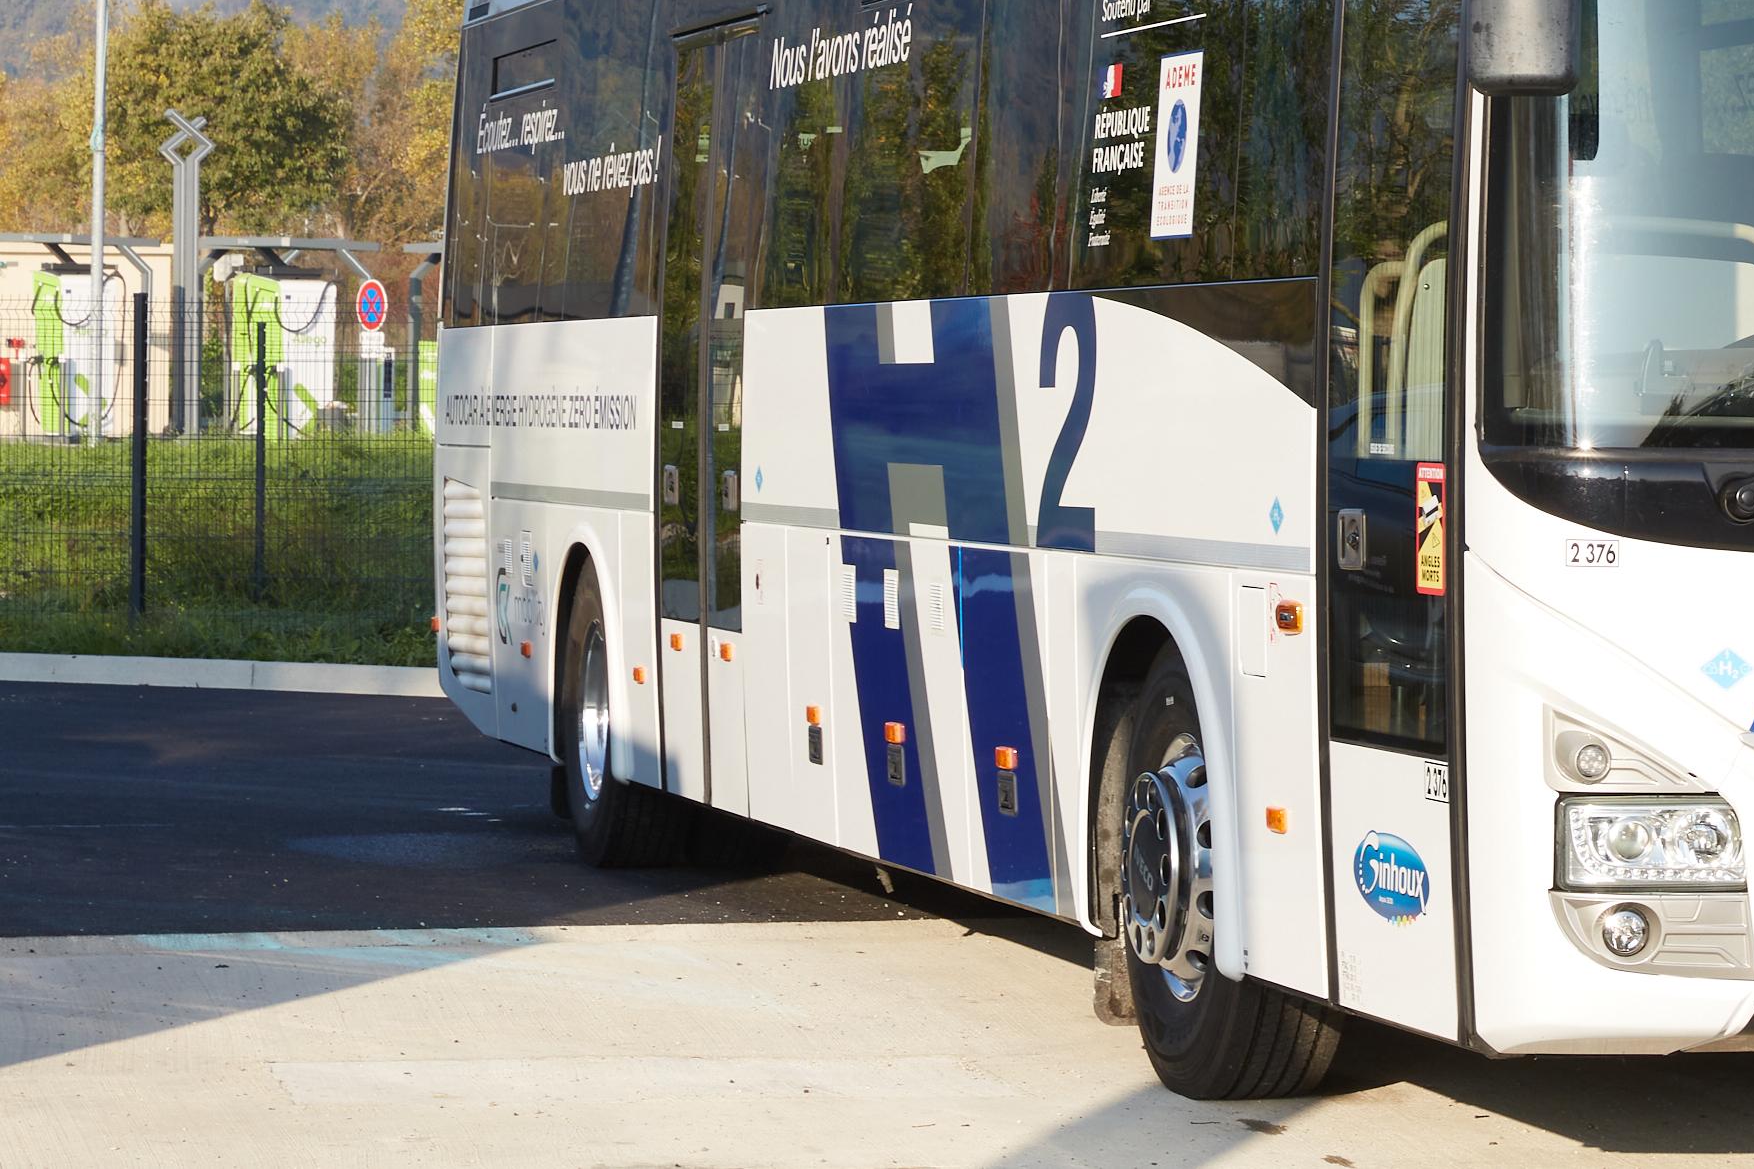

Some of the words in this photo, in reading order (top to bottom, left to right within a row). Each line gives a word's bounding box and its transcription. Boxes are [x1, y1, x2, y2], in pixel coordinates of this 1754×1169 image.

[769, 37, 806, 91] Nous
[807, 27, 860, 82] l'avons
[861, 2, 913, 70] réalisé
[1165, 64, 1196, 90] ADEME
[1094, 106, 1151, 140] RÉPUBLIQUE
[563, 159, 586, 196] vous
[586, 156, 601, 192] ne
[601, 142, 632, 190] rêvez
[630, 148, 653, 198] pas
[1092, 141, 1145, 176] FRANÇAISE
[445, 394, 478, 426] AUTOCAR
[486, 385, 517, 427] ÉNERGIE
[518, 385, 567, 428] HYDROGÈNE
[568, 385, 592, 429] ZÉRO
[594, 385, 637, 430] ÉMISSION
[1418, 466, 1443, 480] ATTENTION
[1420, 554, 1441, 569] ANGLES
[1586, 542, 1616, 565] 376
[1421, 569, 1440, 583] MORTS
[1133, 843, 1154, 892] IVECO
[1359, 831, 1427, 915] Ginhoux
